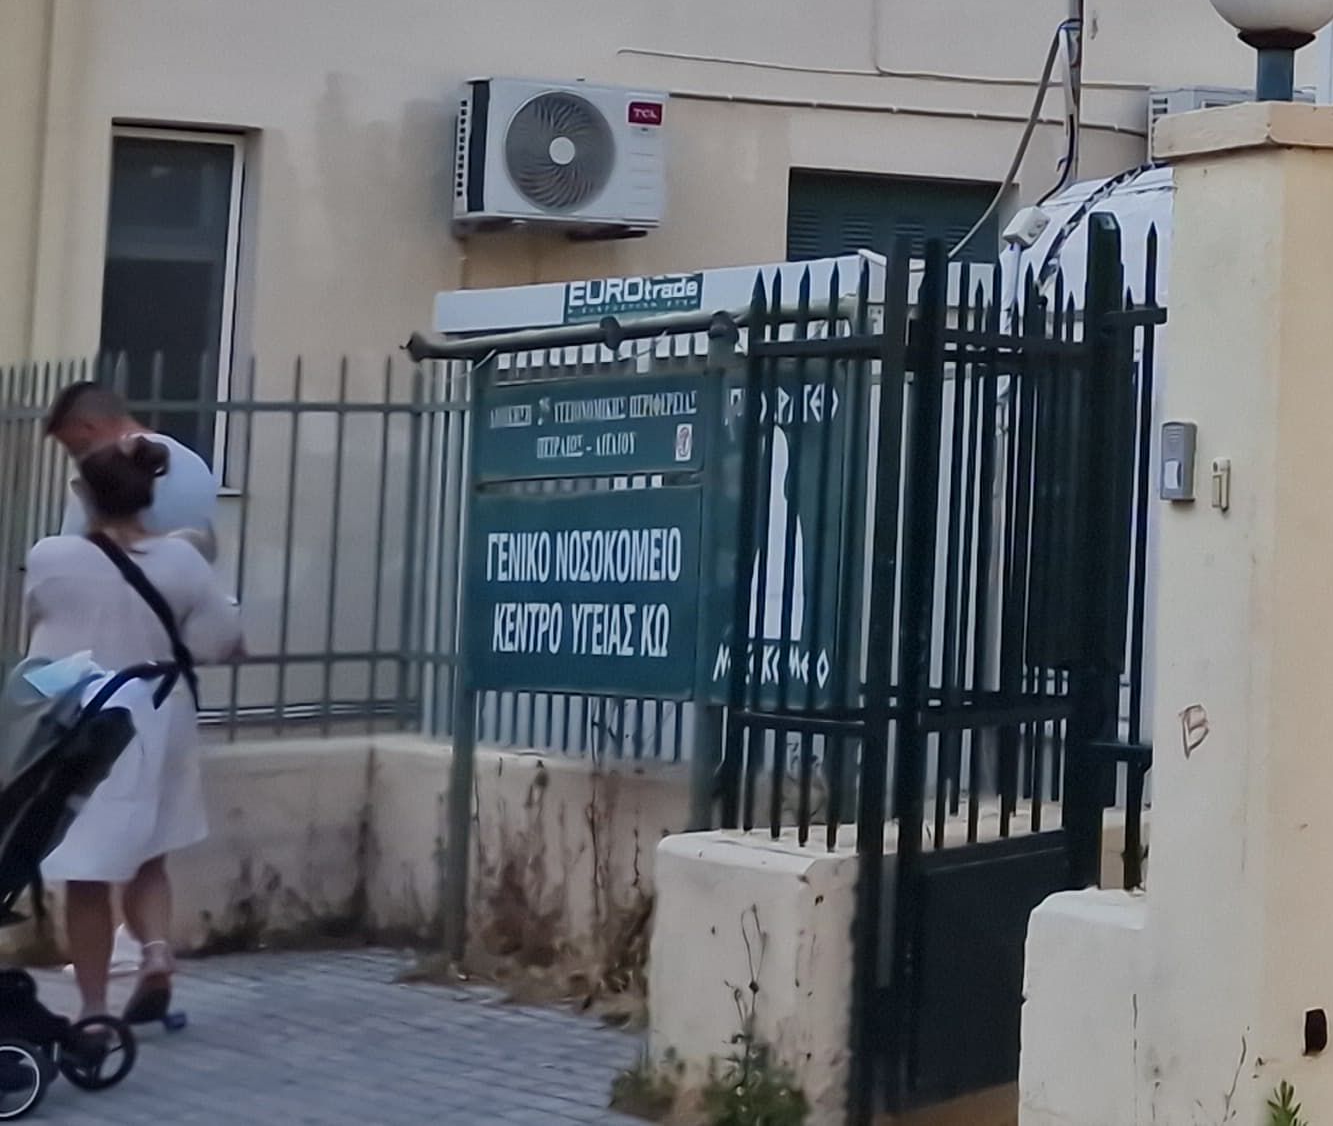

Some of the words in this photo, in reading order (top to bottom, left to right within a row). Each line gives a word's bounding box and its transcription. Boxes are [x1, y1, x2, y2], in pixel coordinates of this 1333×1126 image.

[632, 107, 657, 119] TCL
[569, 276, 698, 307] EUROtrade
[486, 531, 550, 583] ΓΕΝΙΚΟ
[555, 527, 681, 583] ΝΟΣΟΚΟΜΕΙΟ
[492, 602, 563, 654] ΚΕΝΤΡΟ
[571, 602, 636, 656] ΥΓΕΙΑΣ
[640, 603, 670, 657] ΚΩ
